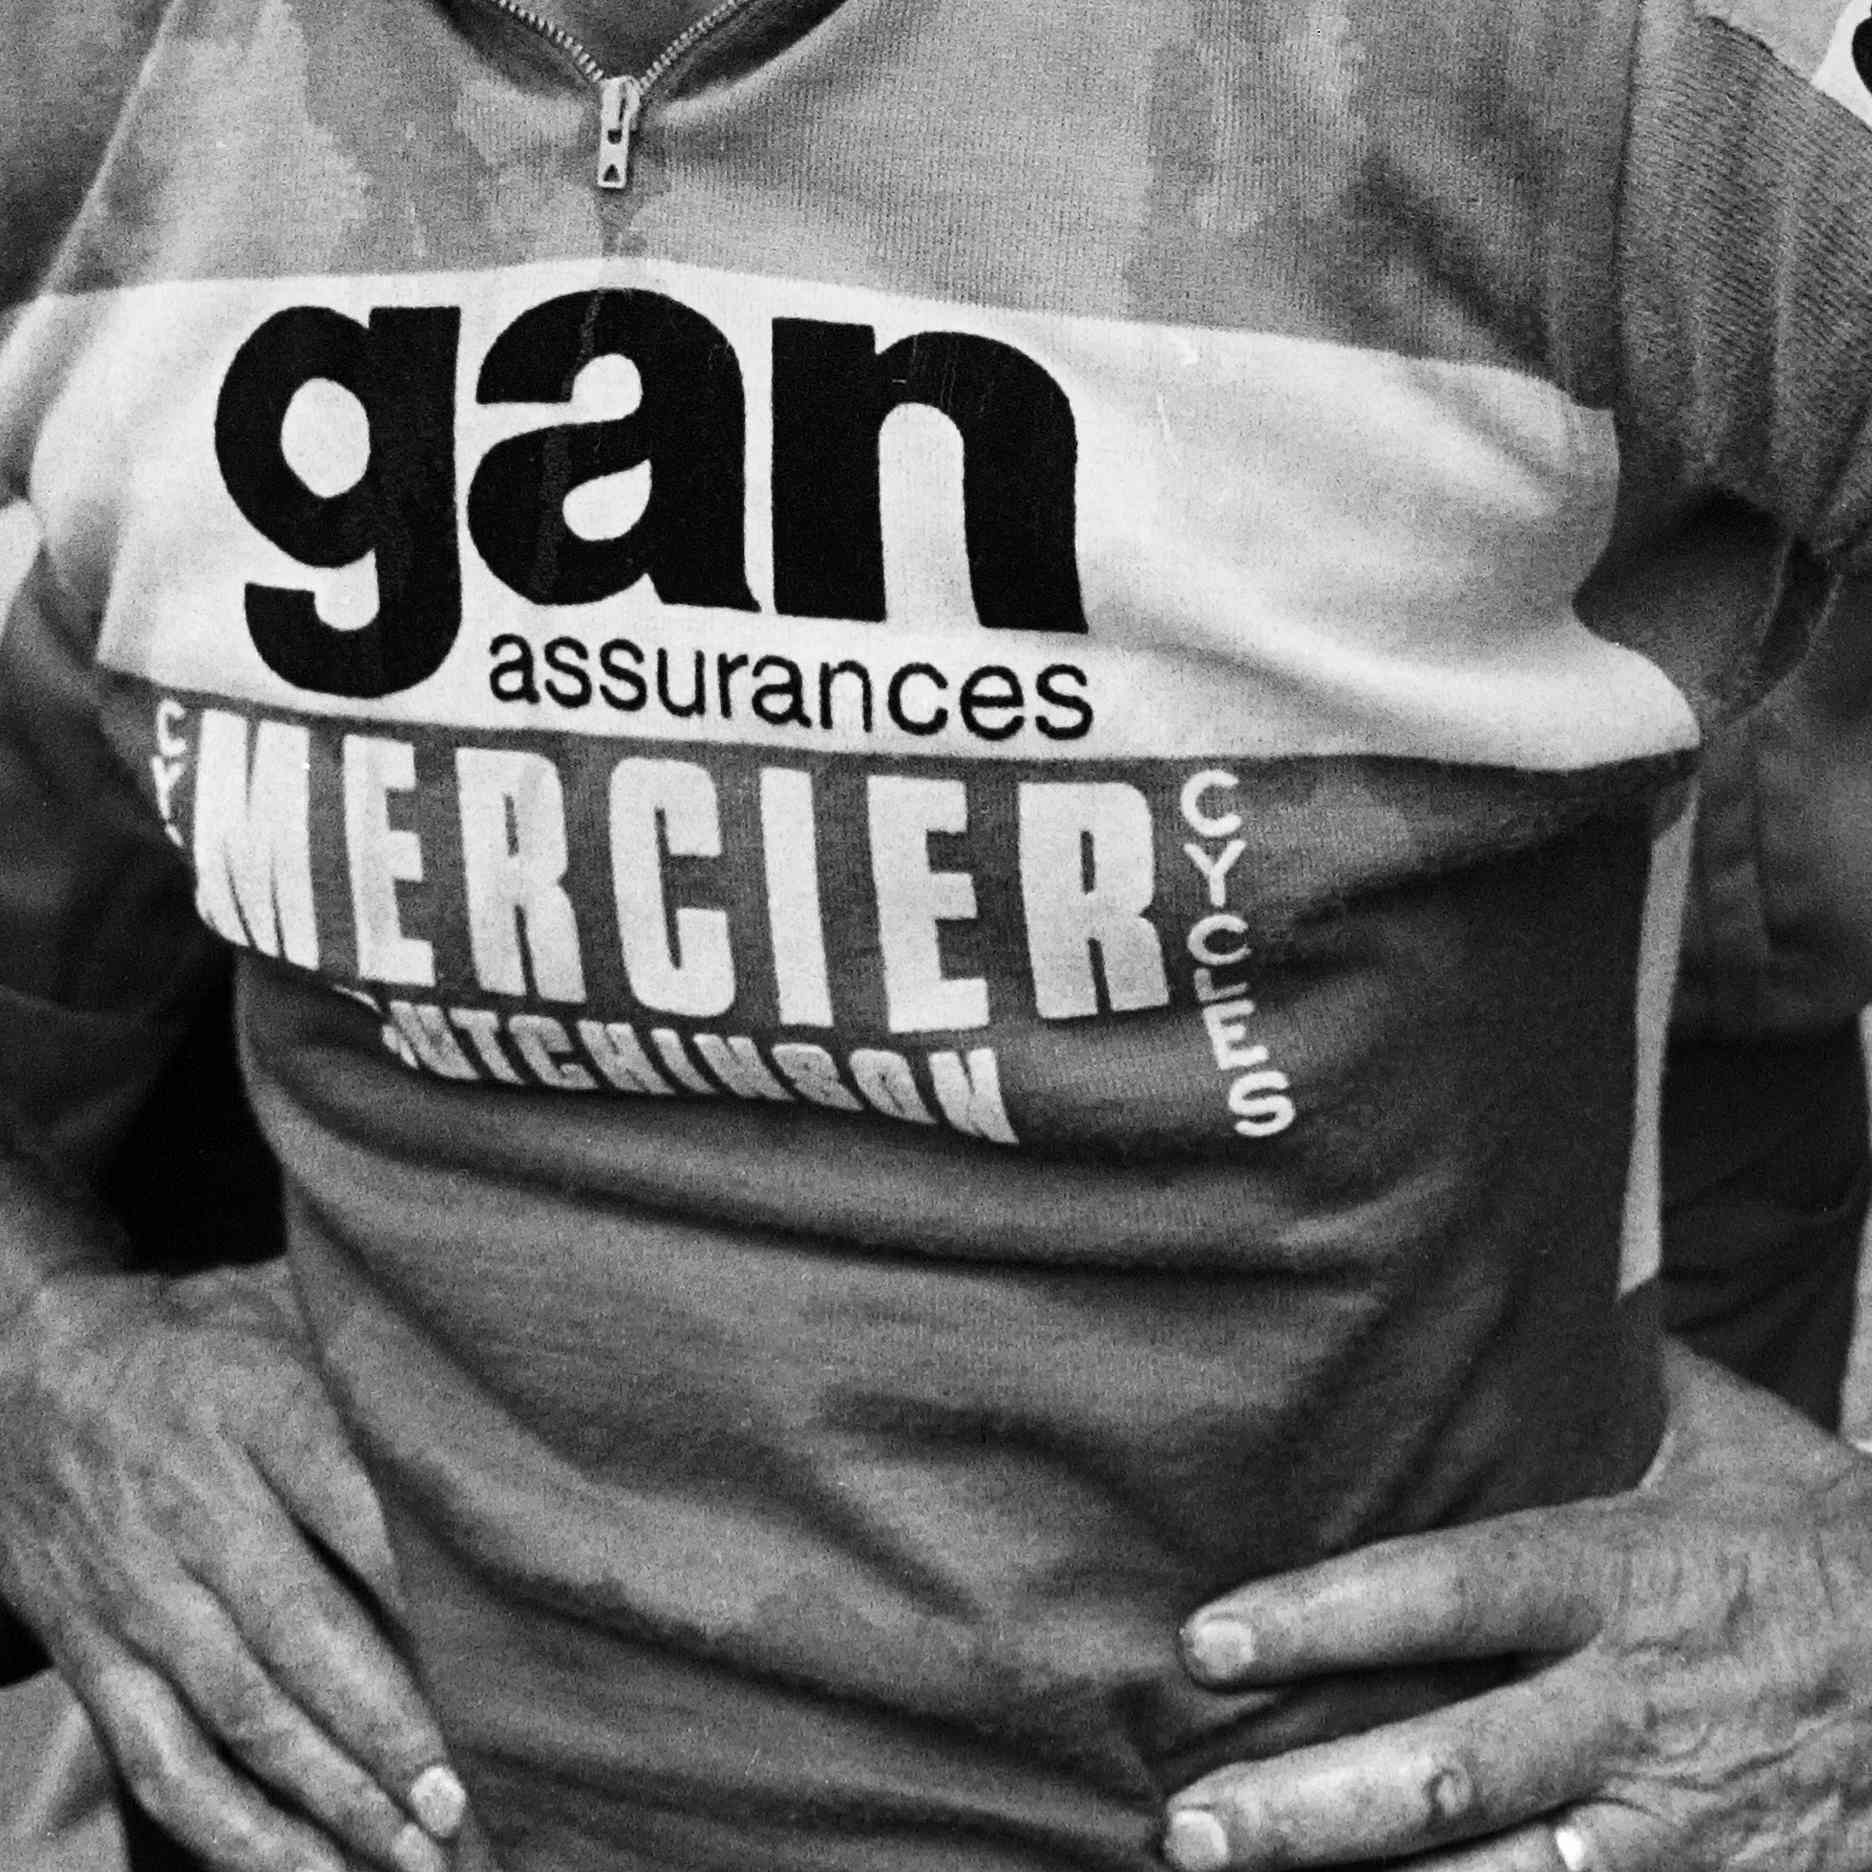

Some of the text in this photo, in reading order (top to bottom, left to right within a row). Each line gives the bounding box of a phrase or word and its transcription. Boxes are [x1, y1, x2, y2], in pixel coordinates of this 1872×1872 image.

[213, 287, 1091, 701] gan
[488, 633, 1094, 743] assurances
[191, 707, 1169, 1034] MERCIER
[1179, 768, 1297, 1138] CYCLES
